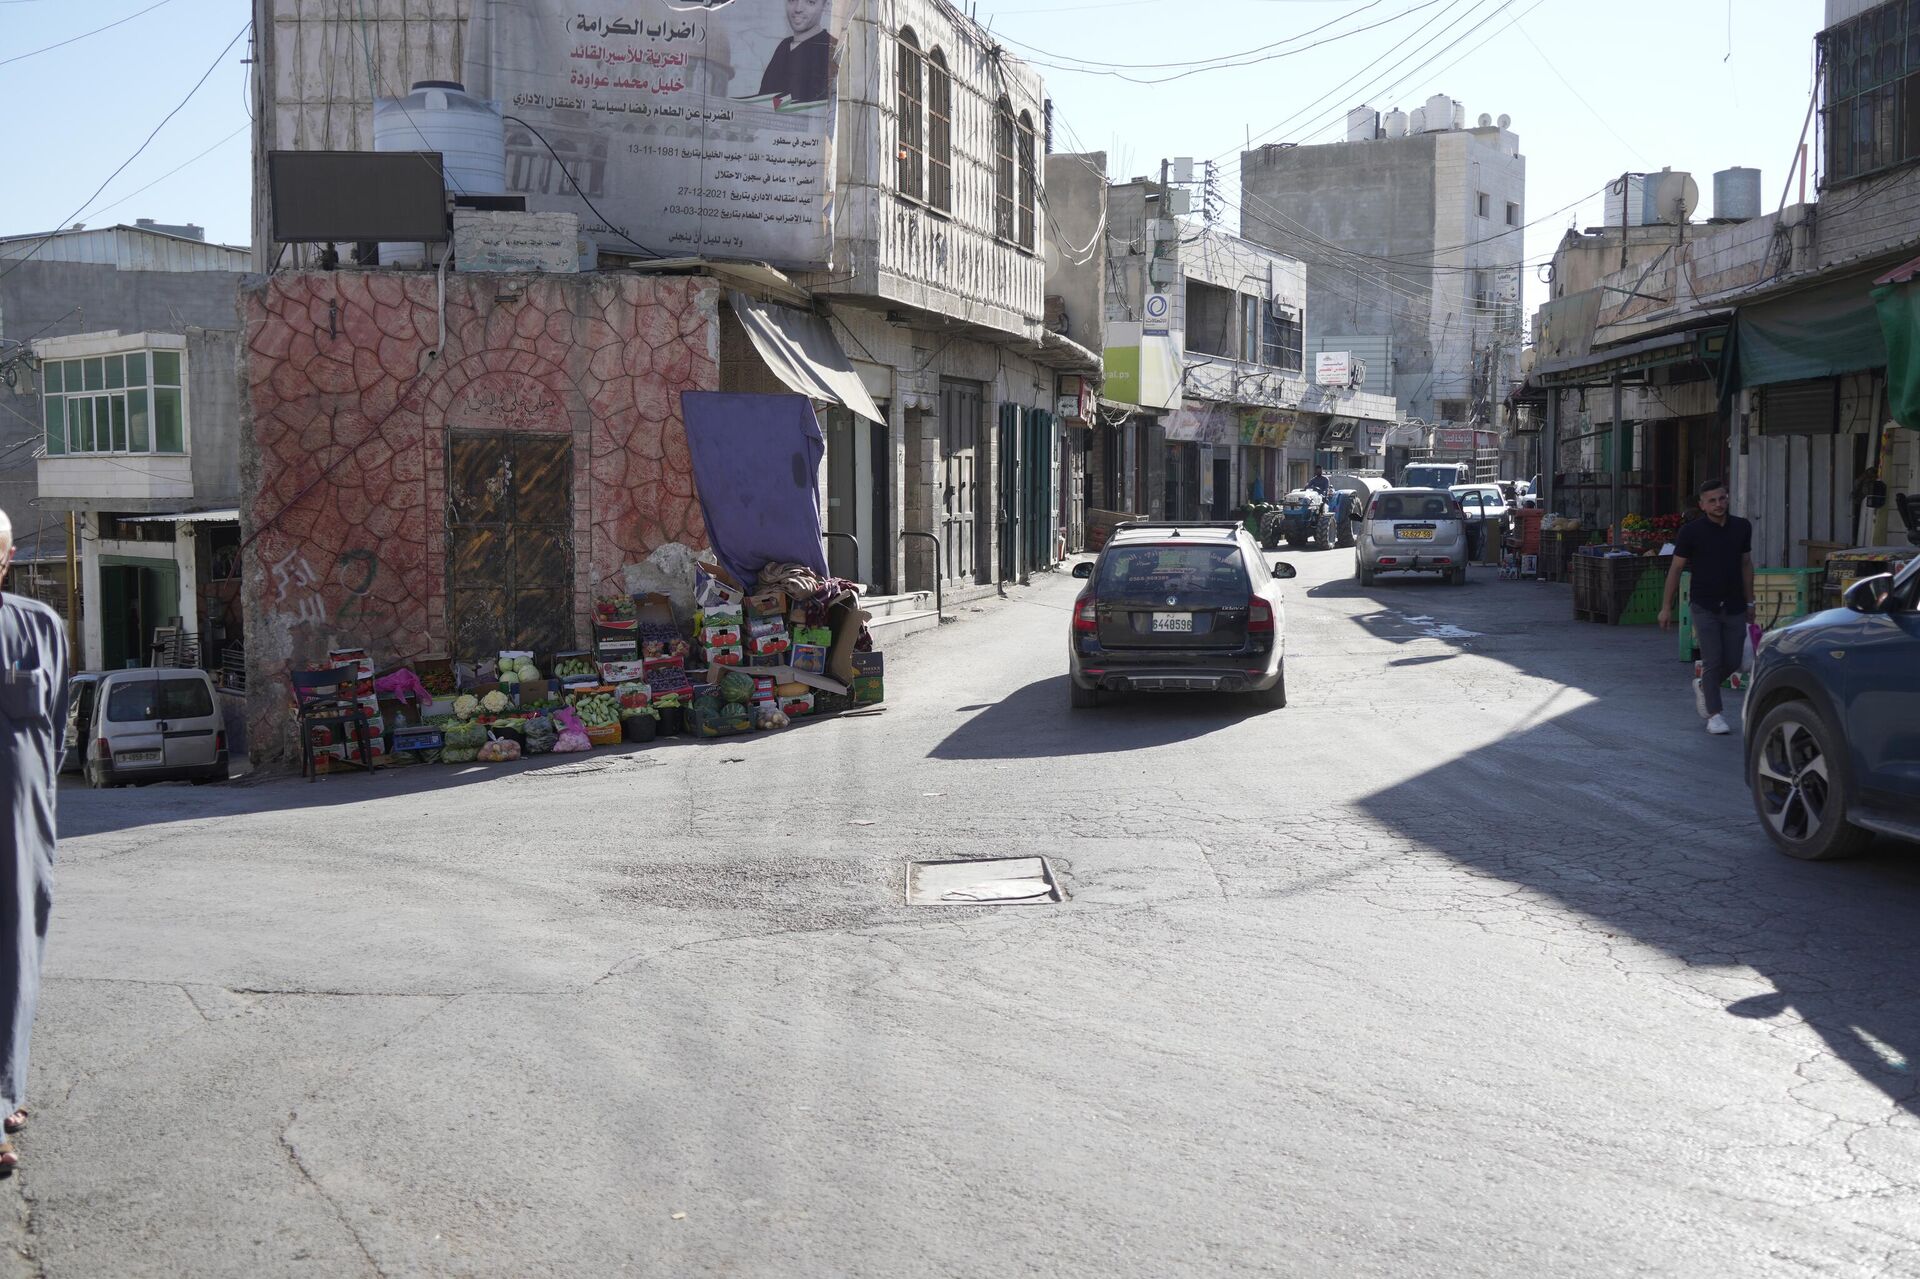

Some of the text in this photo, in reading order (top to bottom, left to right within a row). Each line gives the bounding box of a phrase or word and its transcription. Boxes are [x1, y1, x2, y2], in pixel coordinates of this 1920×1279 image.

[646, 47, 688, 68] الحرية
[570, 69, 685, 95] خليل محمد عواودة
[592, 102, 627, 115] لسياسة
[653, 106, 684, 118] الطعام
[685, 108, 700, 121] عن
[702, 110, 734, 122] المضرب
[772, 137, 791, 146] سطور
[791, 137, 800, 148] في
[628, 144, 679, 157] 13-11-1981
[681, 148, 702, 159] بتاريخ
[724, 154, 742, 163] جنوب
[765, 154, 786, 165] مدينة
[787, 156, 806, 167] مواليد
[806, 158, 817, 168] من
[714, 170, 742, 180] الاحتلال
[742, 174, 761, 183] سجون
[762, 173, 771, 184] في
[678, 186, 727, 199] 27-12-2021
[730, 190, 751, 201] بتاريخ
[774, 194, 798, 204] اعتقاله
[669, 205, 720, 218] 03-03-2022
[720, 208, 741, 219] بتاريخ
[741, 211, 763, 221] الطعام
[1152, 619, 1192, 631] 6448596
